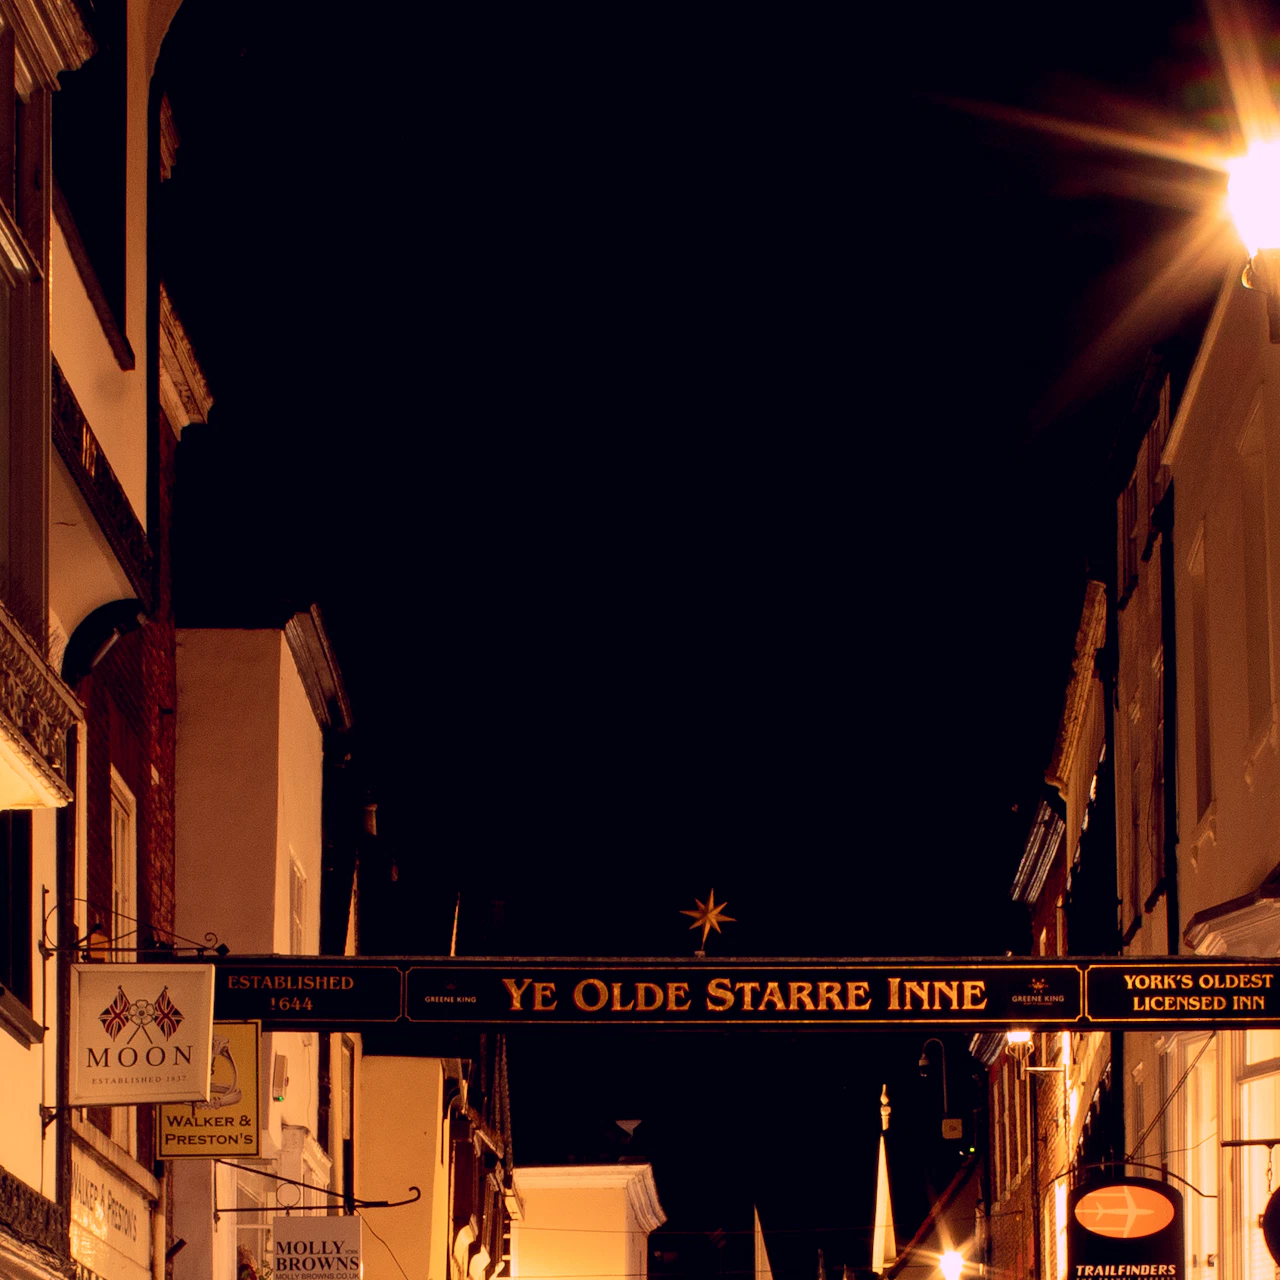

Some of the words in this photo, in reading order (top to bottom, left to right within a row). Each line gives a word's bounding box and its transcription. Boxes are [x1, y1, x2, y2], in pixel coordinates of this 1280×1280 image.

[227, 975, 355, 990] ESTABLISHED
[1123, 973, 1194, 990] YORK'S
[1198, 973, 1275, 990] OLDEST
[424, 996, 456, 1004] GREENE
[457, 996, 478, 1004] KING
[502, 978, 559, 1011] YE
[574, 978, 693, 1012] OLDE
[706, 977, 873, 1011] STARRE
[887, 977, 989, 1010] INNE
[1011, 995, 1043, 1003] GREENE
[1044, 995, 1065, 1003] KING
[1132, 995, 1227, 1012] LICENSED
[1232, 995, 1266, 1011] INN
[85, 1044, 194, 1068] MOON
[91, 1076, 163, 1086] ESTABLISHED
[166, 1115, 235, 1128] WALKER
[238, 1114, 252, 1127] &
[164, 1132, 254, 1146] PRESTON'S
[276, 1240, 345, 1256] MOLLY
[275, 1256, 360, 1272] BROWNS
[1075, 1264, 1177, 1277] TRAILFINDERS
[275, 1273, 301, 1280] MOLLY
